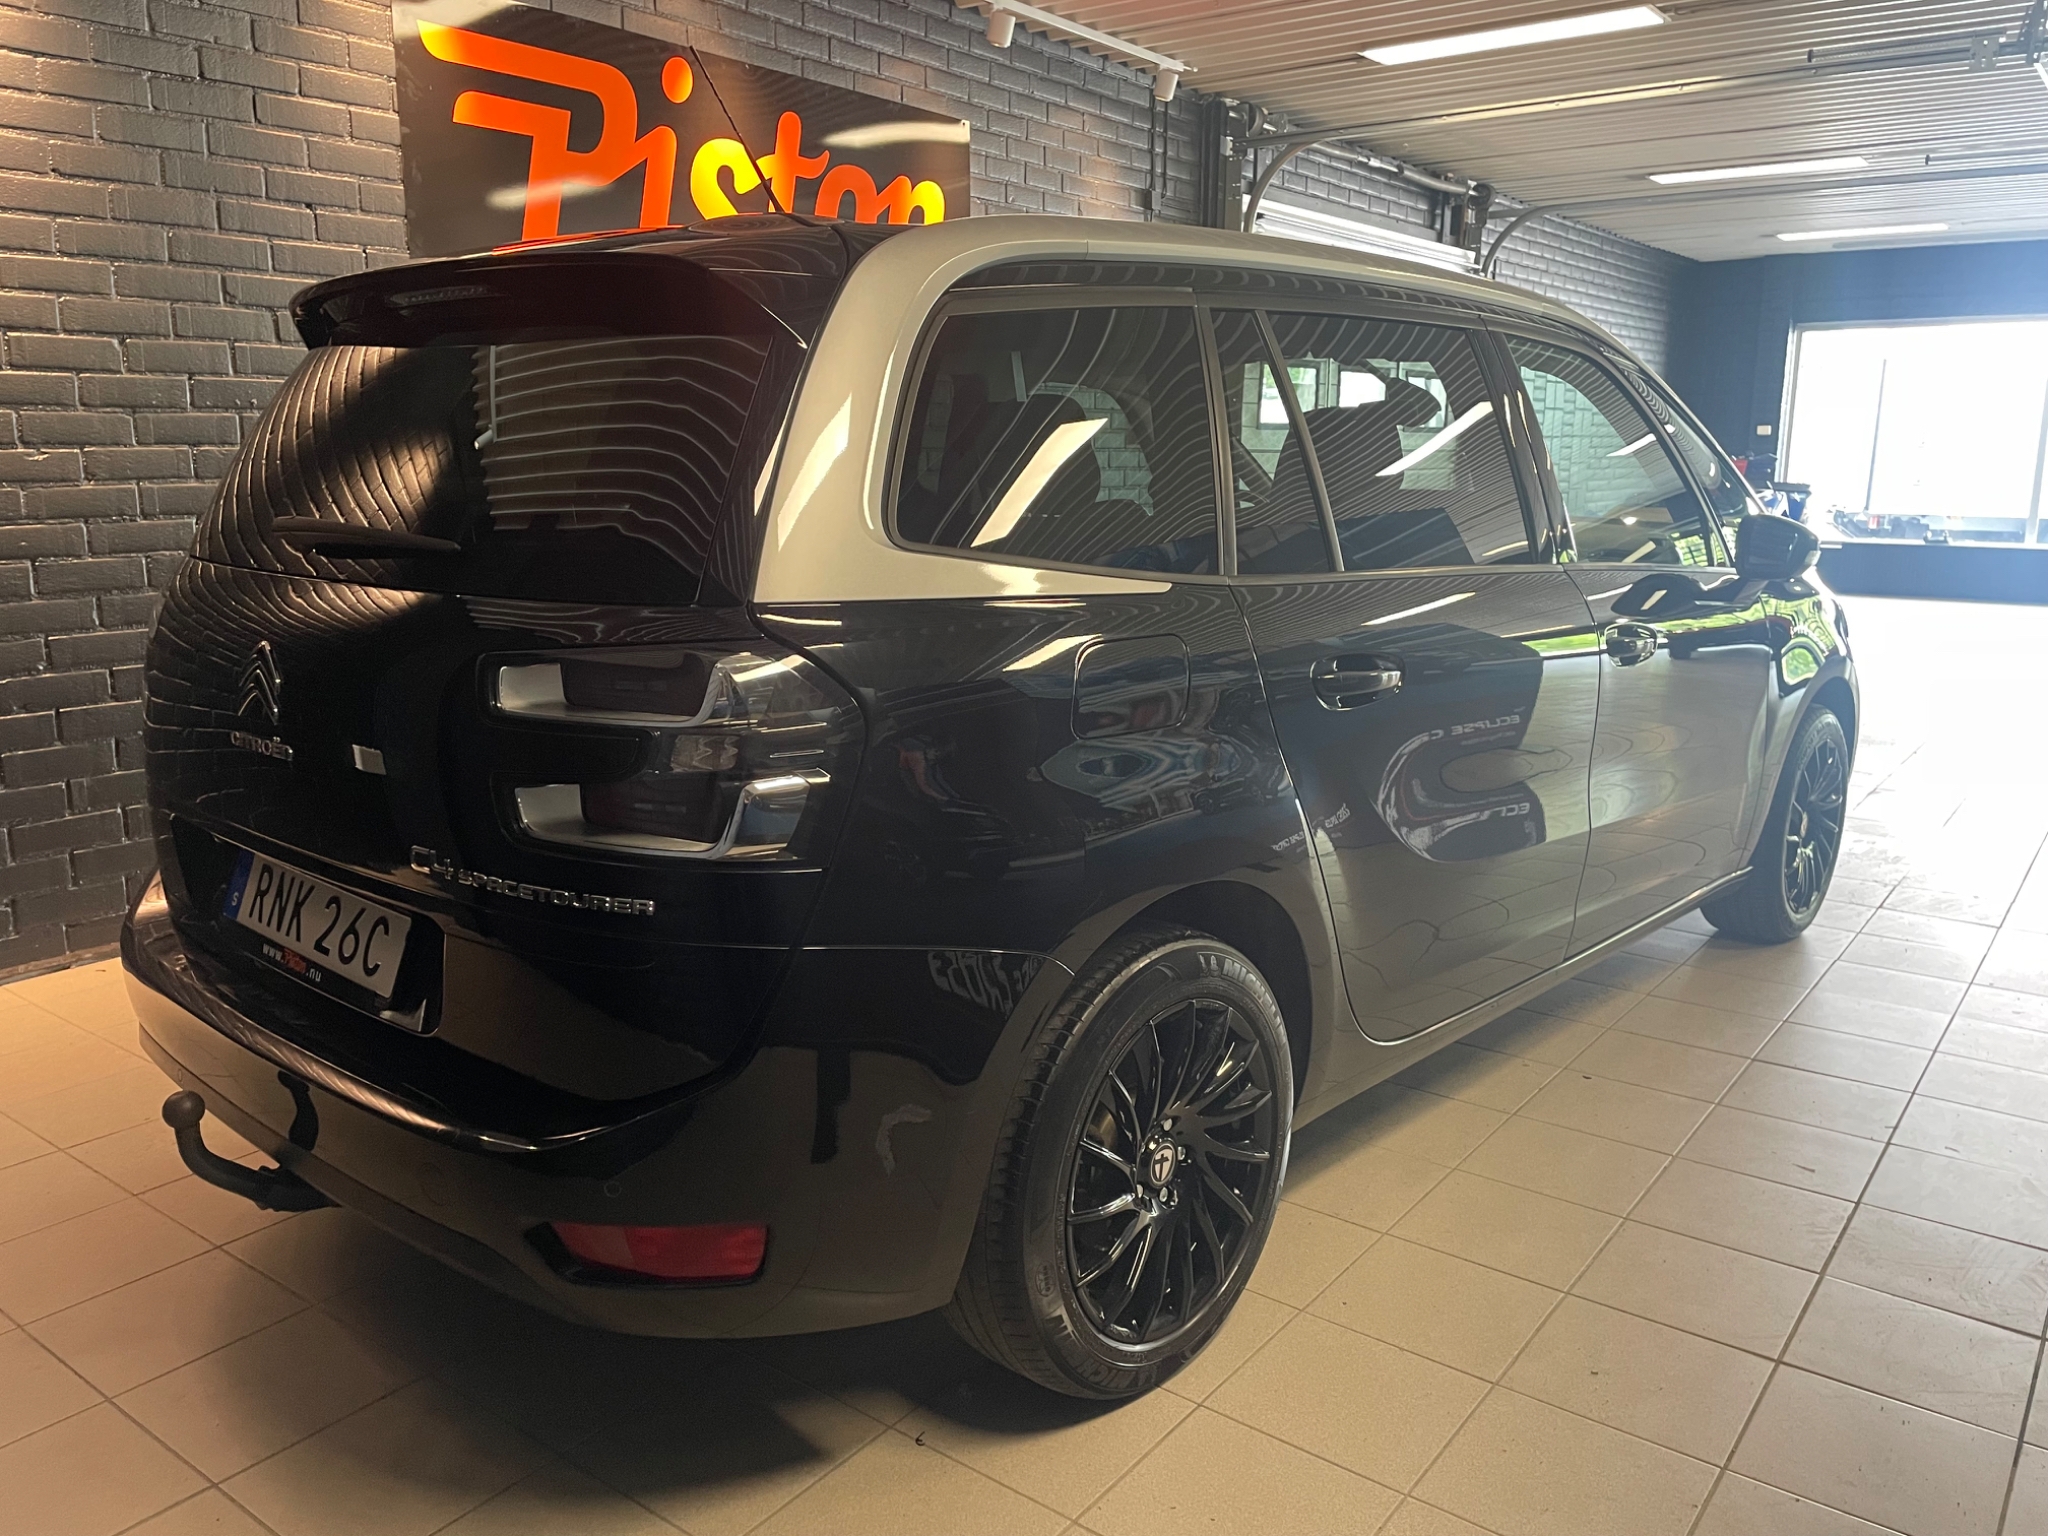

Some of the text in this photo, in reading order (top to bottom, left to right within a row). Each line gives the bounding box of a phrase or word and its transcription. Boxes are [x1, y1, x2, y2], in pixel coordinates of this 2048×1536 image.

[249, 863, 390, 977] RNK 26C
[458, 868, 655, 916] SPACETOURER
